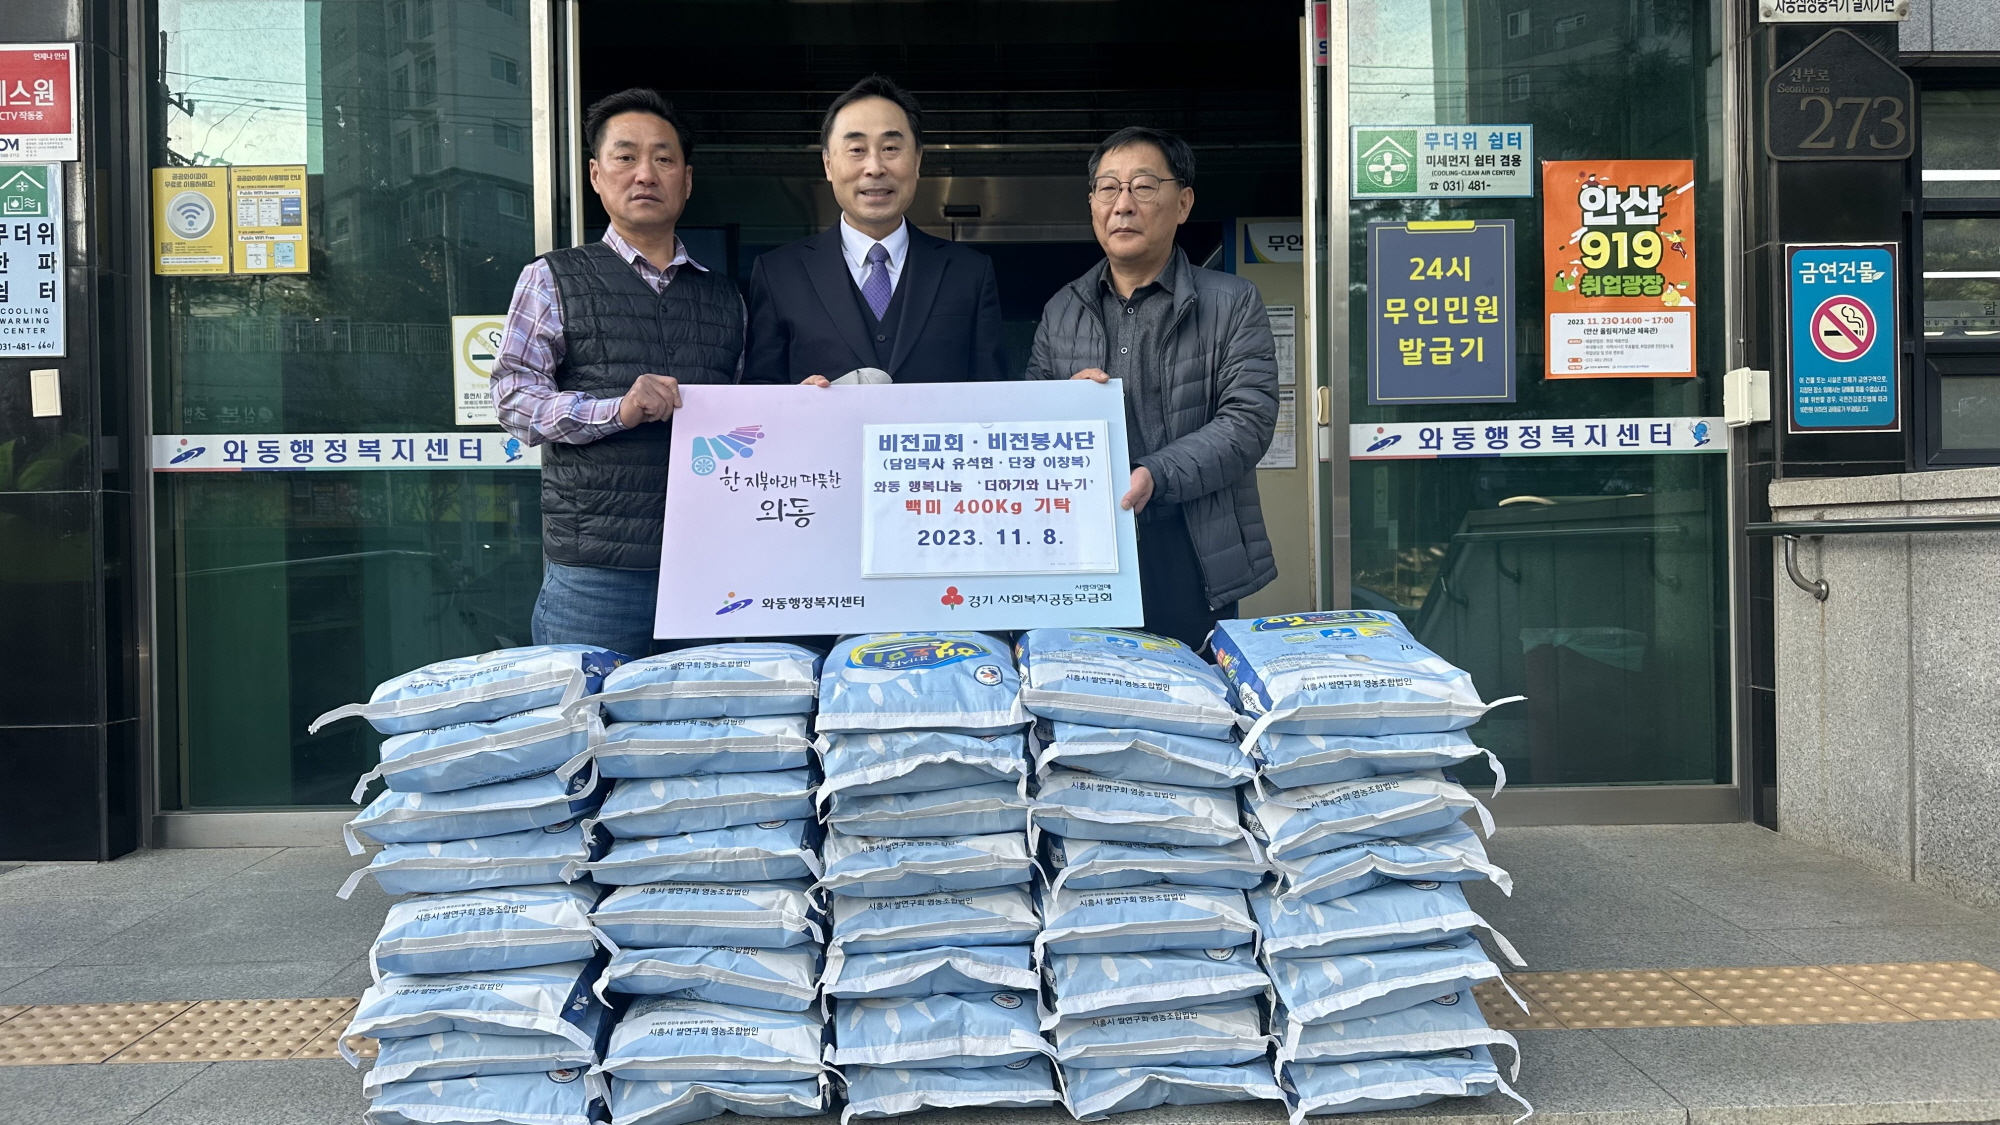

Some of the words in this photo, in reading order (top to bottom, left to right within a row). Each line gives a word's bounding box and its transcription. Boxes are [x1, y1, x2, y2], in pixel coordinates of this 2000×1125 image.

[1790, 68, 1830, 82] 선부로
[1778, 84, 1830, 94] Seonbu-ro
[19, 112, 44, 120] 작동중
[1798, 96, 1906, 150] 273
[1424, 132, 1478, 150] 무더위
[1488, 132, 1522, 150] 쉼터
[1426, 154, 1470, 167] 미세먼지
[1474, 154, 1495, 166] 쉼터
[1500, 154, 1522, 166] 겸용
[1443, 180, 1464, 192] 031)
[1468, 180, 1491, 191] 481-
[1580, 186, 1662, 226] 안산
[1581, 230, 1662, 269] 919
[1410, 256, 1470, 282] 24시
[1799, 261, 1876, 284] 금연건물
[1581, 275, 1664, 296] 취업광장
[1384, 296, 1498, 325] 무인민원
[1399, 337, 1483, 365] 발급기
[879, 434, 964, 452] 비전교회
[988, 431, 1095, 451] 비전봉사단
[1418, 422, 1672, 451] 와동행정복지센터
[222, 438, 482, 464] 와동행정복지센터
[883, 458, 944, 470] (담임목사
[952, 457, 994, 469] 유석현
[1008, 456, 1035, 469] 단장
[1044, 456, 1091, 468] 이창복)
[720, 466, 740, 491] 한
[746, 470, 797, 491] 지붕아래
[800, 470, 842, 489] 따뜻한
[874, 481, 900, 492] 와동
[909, 480, 963, 492] 행복나눔
[756, 498, 816, 528] 와동
[905, 499, 942, 515] 백미
[954, 499, 1023, 515] 400Kg
[1034, 498, 1070, 513] 기탁
[917, 530, 983, 546] 2023.
[996, 529, 1031, 545] 11.
[1043, 528, 1064, 544] 8.
[762, 596, 865, 609] 와동행정복지센터
[968, 595, 993, 608] 경기
[998, 592, 1112, 606] 사회복지공동모금회
[1065, 673, 1089, 683] 시흥시
[1091, 676, 1122, 686] 쌀연구회
[1124, 680, 1170, 691] 영농조합법인
[1302, 682, 1326, 692] 시흥시
[1328, 680, 1361, 689] 쌀연구회
[1363, 678, 1412, 688] 영농조합법인
[1071, 782, 1094, 791] 시흥시
[1097, 784, 1128, 794] 쌀연구회
[1352, 780, 1400, 799] 영농조합법인
[861, 845, 883, 853] 시흥시
[894, 900, 925, 909] 쌀연구회
[927, 897, 973, 906] 영농조합법인
[1080, 899, 1103, 907] 시흥시
[1106, 896, 1137, 905] 쌀연구회
[1139, 893, 1186, 902] 영농조합법인
[414, 912, 439, 922] 시흥시
[442, 909, 475, 920] 쌀연구회
[478, 904, 527, 916] 영농조합법인
[1092, 1019, 1115, 1028] 시흥시
[1117, 1016, 1149, 1025] 쌀연구회
[1151, 1012, 1198, 1022] 영농조합법인
[676, 1027, 708, 1036] 쌀연구회
[711, 1027, 758, 1036] 영농조합법인
